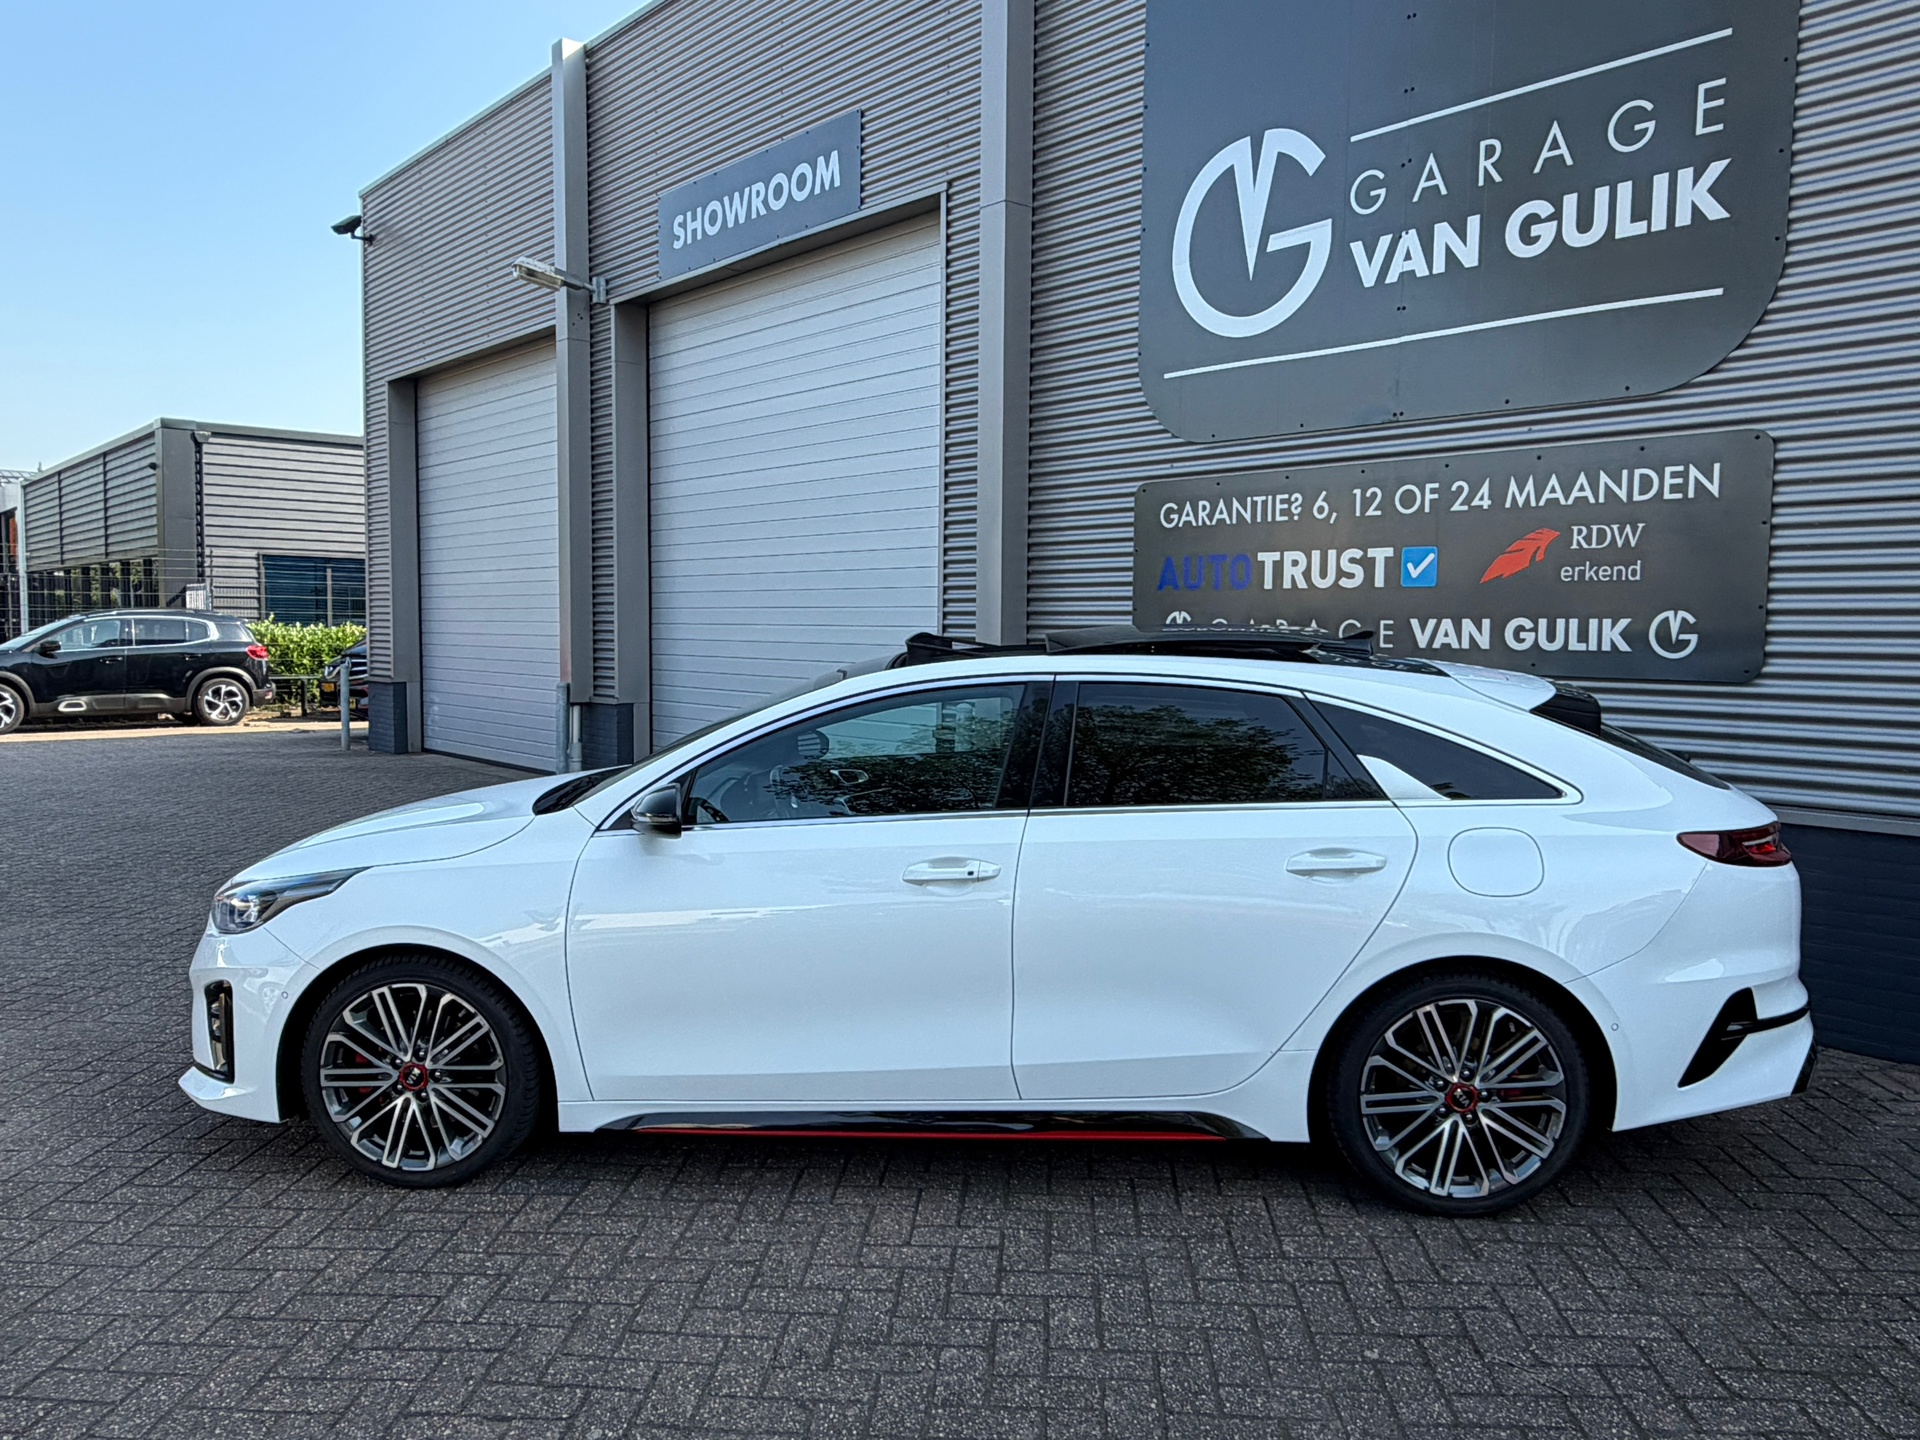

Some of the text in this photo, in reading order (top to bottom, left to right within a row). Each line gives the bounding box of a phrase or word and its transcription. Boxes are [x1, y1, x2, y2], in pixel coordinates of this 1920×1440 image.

[1350, 78, 1726, 215] GARAGE
[672, 149, 841, 250] SHOWROOM
[1349, 158, 1732, 288] VAN GULIK
[1159, 462, 1721, 529] GARANTIE? 6, 12 OF 24 MAANDEN
[1570, 522, 1646, 549] RDW
[1560, 560, 1642, 582] erkend
[1409, 618, 1491, 649] VAN
[1504, 617, 1633, 652] GULIK
